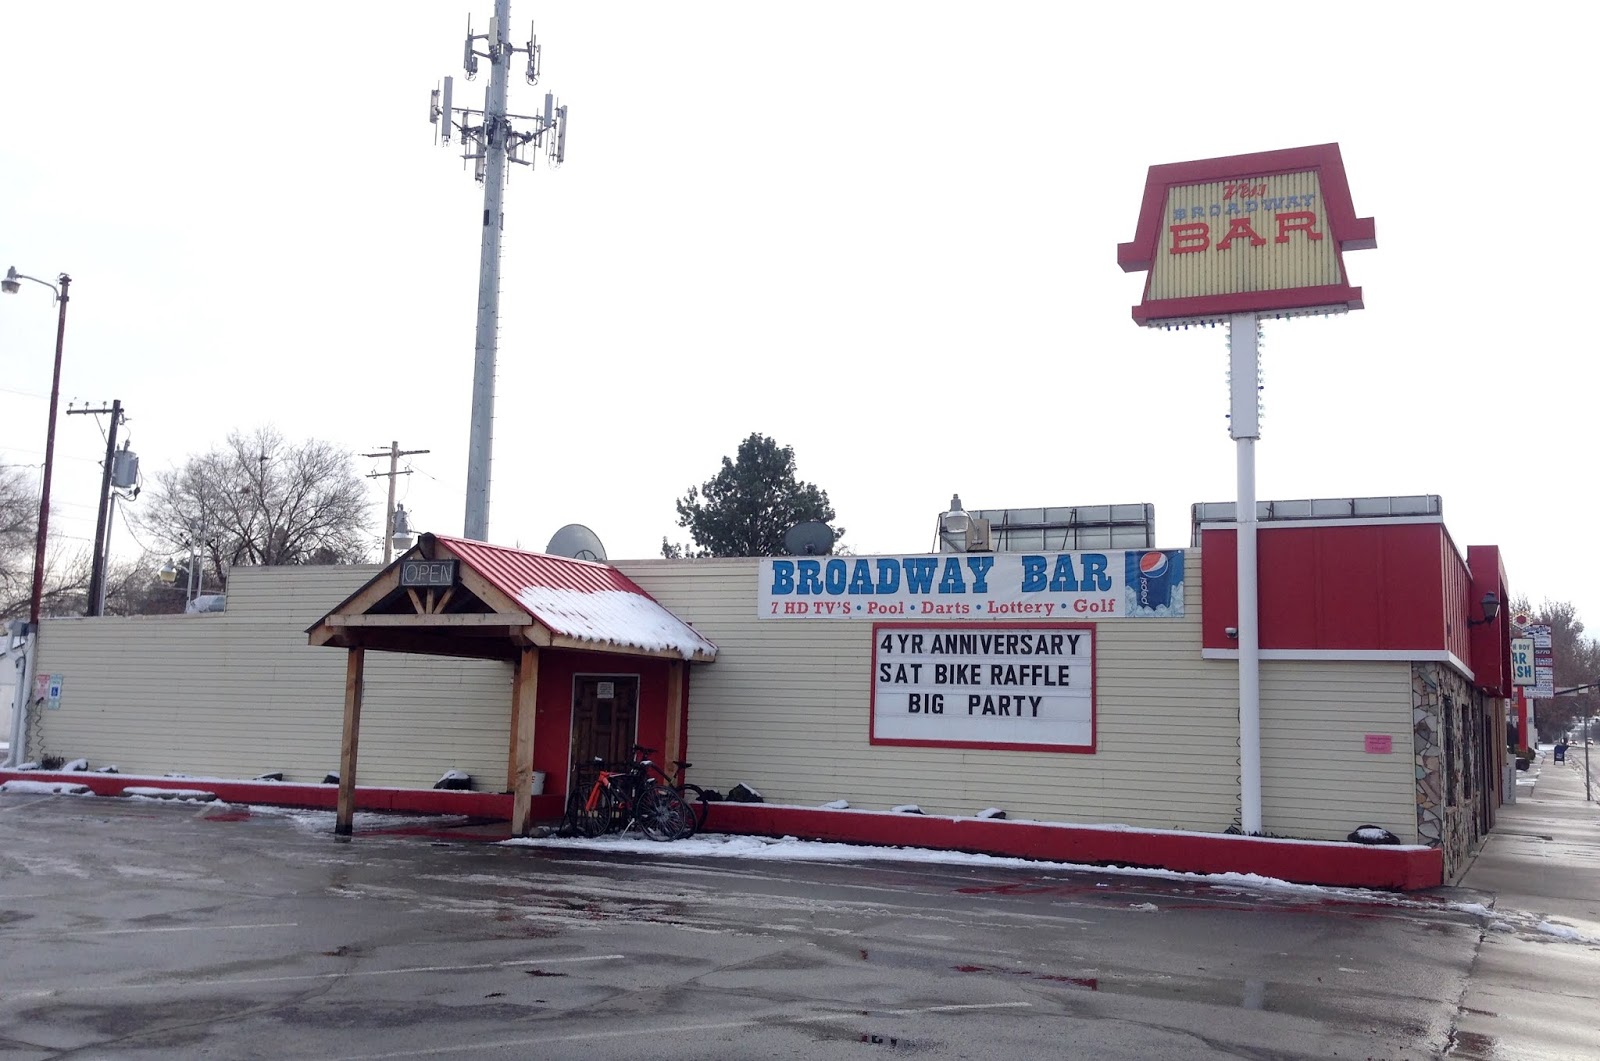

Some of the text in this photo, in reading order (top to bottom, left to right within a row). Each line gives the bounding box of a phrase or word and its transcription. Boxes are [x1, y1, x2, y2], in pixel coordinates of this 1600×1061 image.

[1173, 193, 1315, 220] BROADWAY
[1169, 211, 1323, 254] BAR
[405, 564, 452, 583] OPEN
[771, 553, 1112, 595] BROADWAY BAR
[1140, 576, 1149, 605] pepsi
[771, 602, 779, 614] 7
[813, 601, 851, 614] TV'S
[867, 602, 905, 614] Pool
[921, 601, 970, 614] Darts
[987, 600, 1054, 616] Lottery
[1073, 599, 1116, 613] Golf
[930, 634, 1081, 655] ANNIVERSARY
[880, 663, 1069, 686] SAT BIKE RAFFLE
[908, 693, 1042, 717] BIG PARTY
